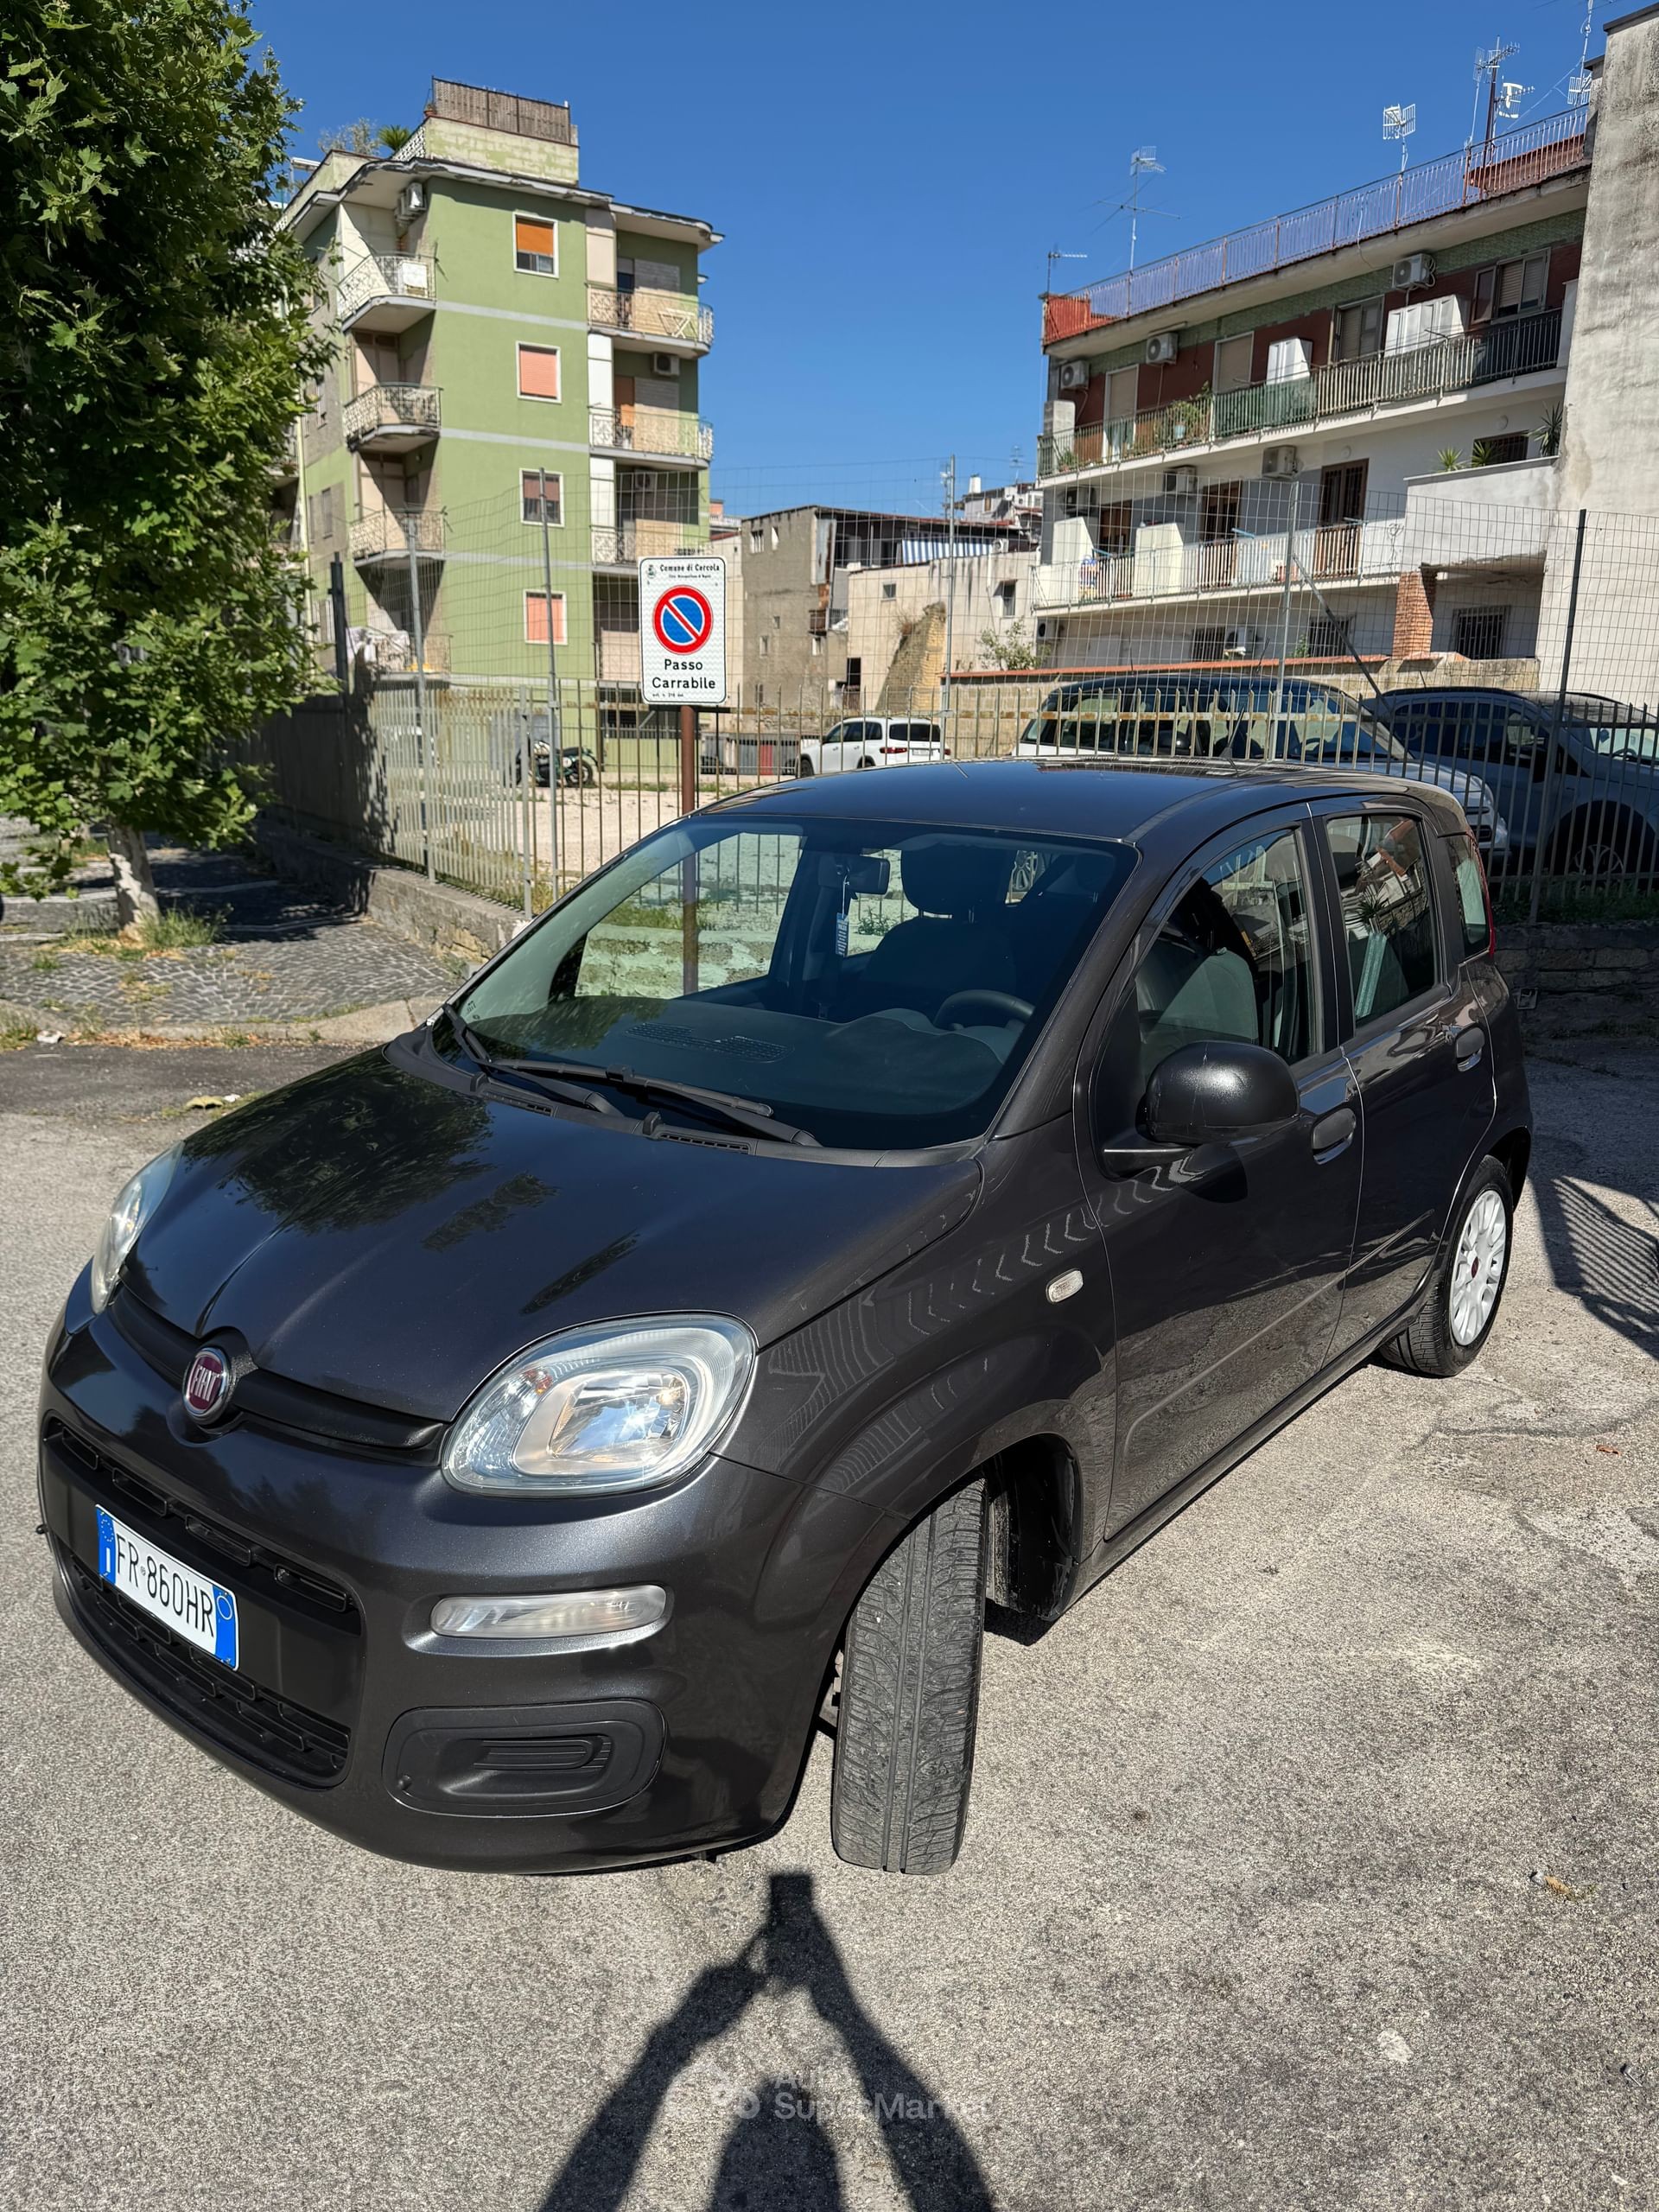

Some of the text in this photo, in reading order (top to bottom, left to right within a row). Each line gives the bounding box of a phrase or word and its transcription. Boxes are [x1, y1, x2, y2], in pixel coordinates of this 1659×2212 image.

[659, 563, 684, 572] Comune
[686, 563, 693, 572] di
[664, 658, 703, 671] Passo
[652, 677, 716, 689] Carrabile
[189, 1364, 220, 1402] FIAT
